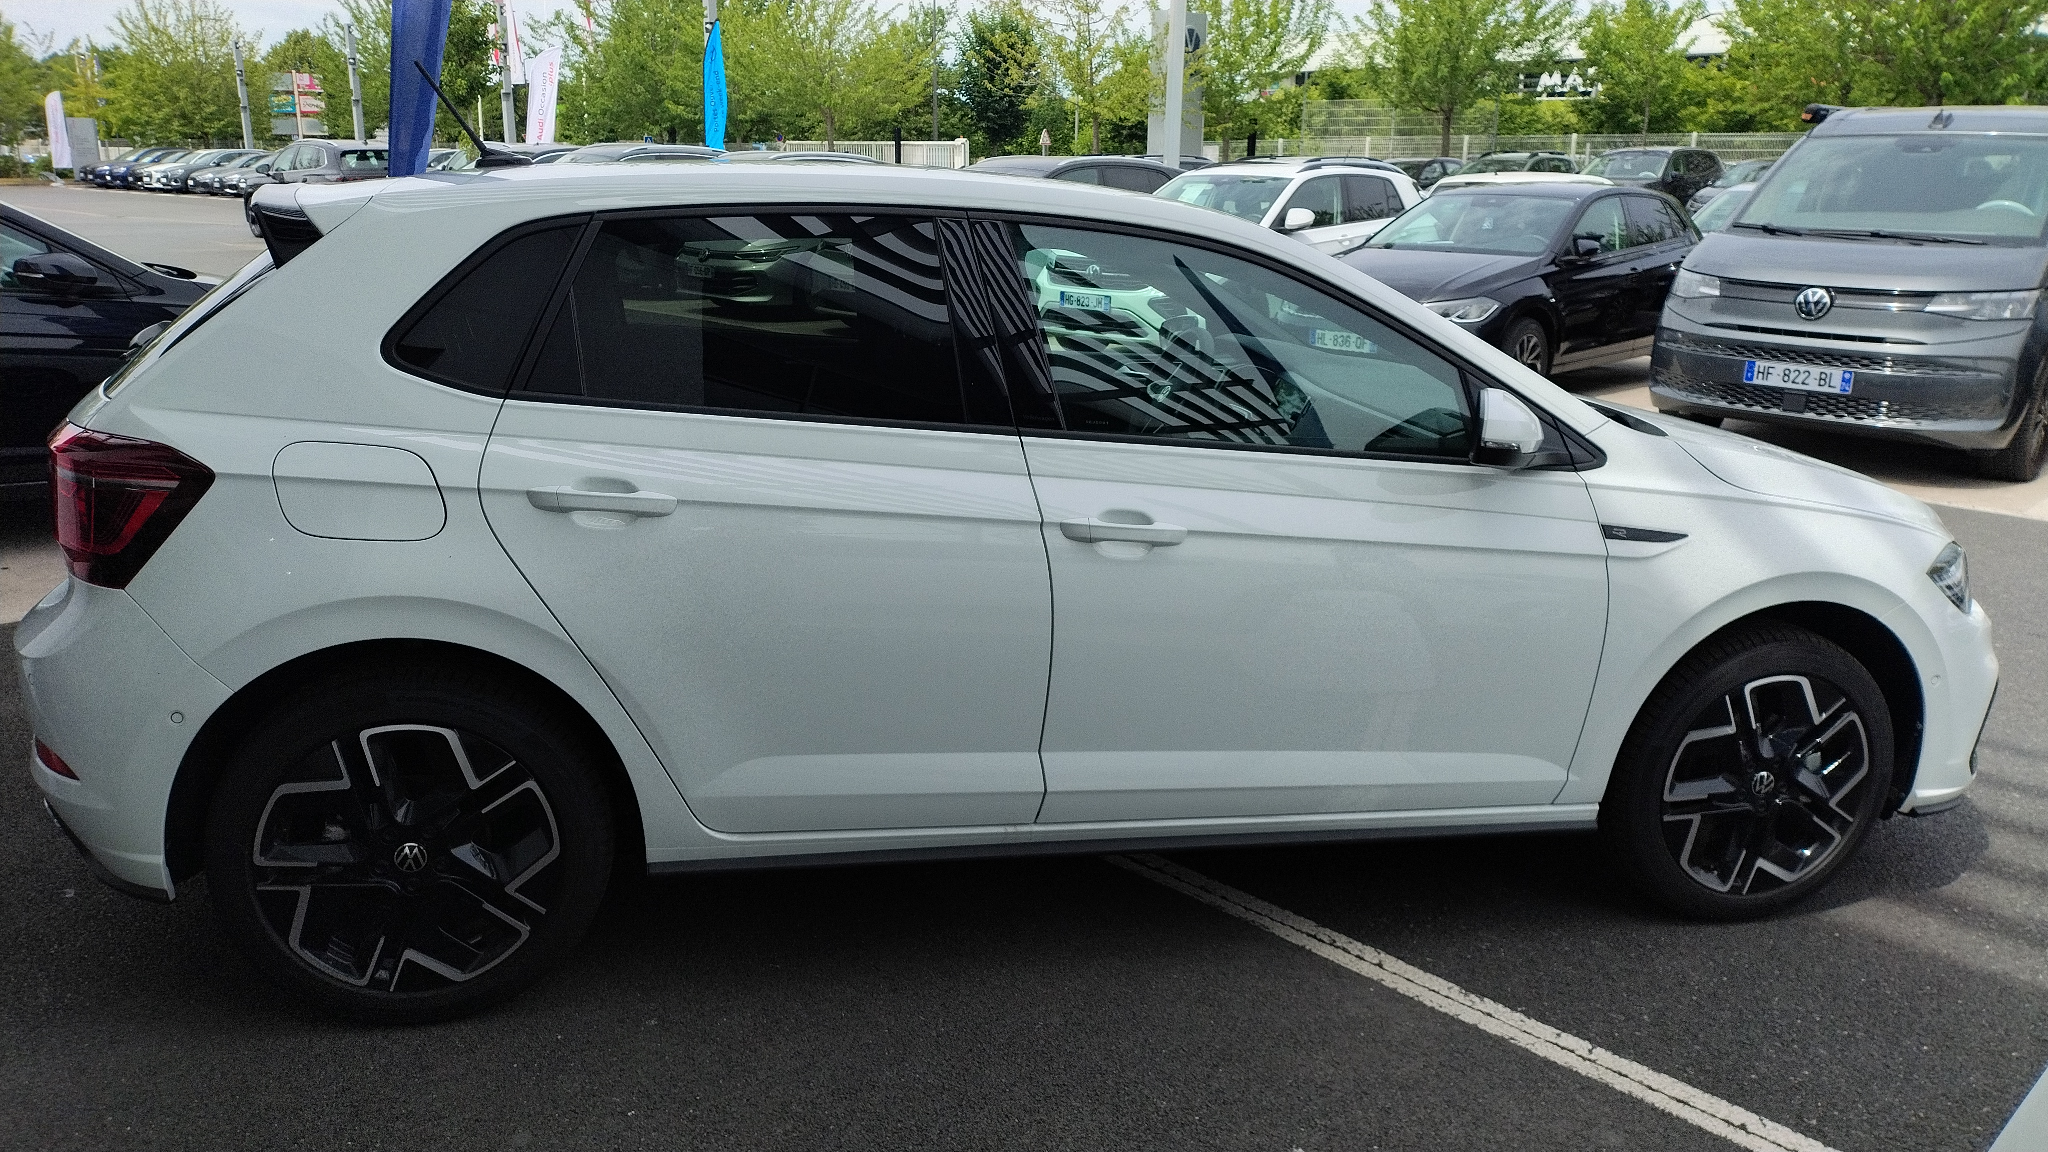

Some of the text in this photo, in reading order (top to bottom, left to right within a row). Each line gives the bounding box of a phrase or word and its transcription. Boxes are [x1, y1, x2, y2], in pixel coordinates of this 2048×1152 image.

[536, 71, 548, 141] Audi Occasion
[1756, 364, 1837, 389] HF-822-BL
